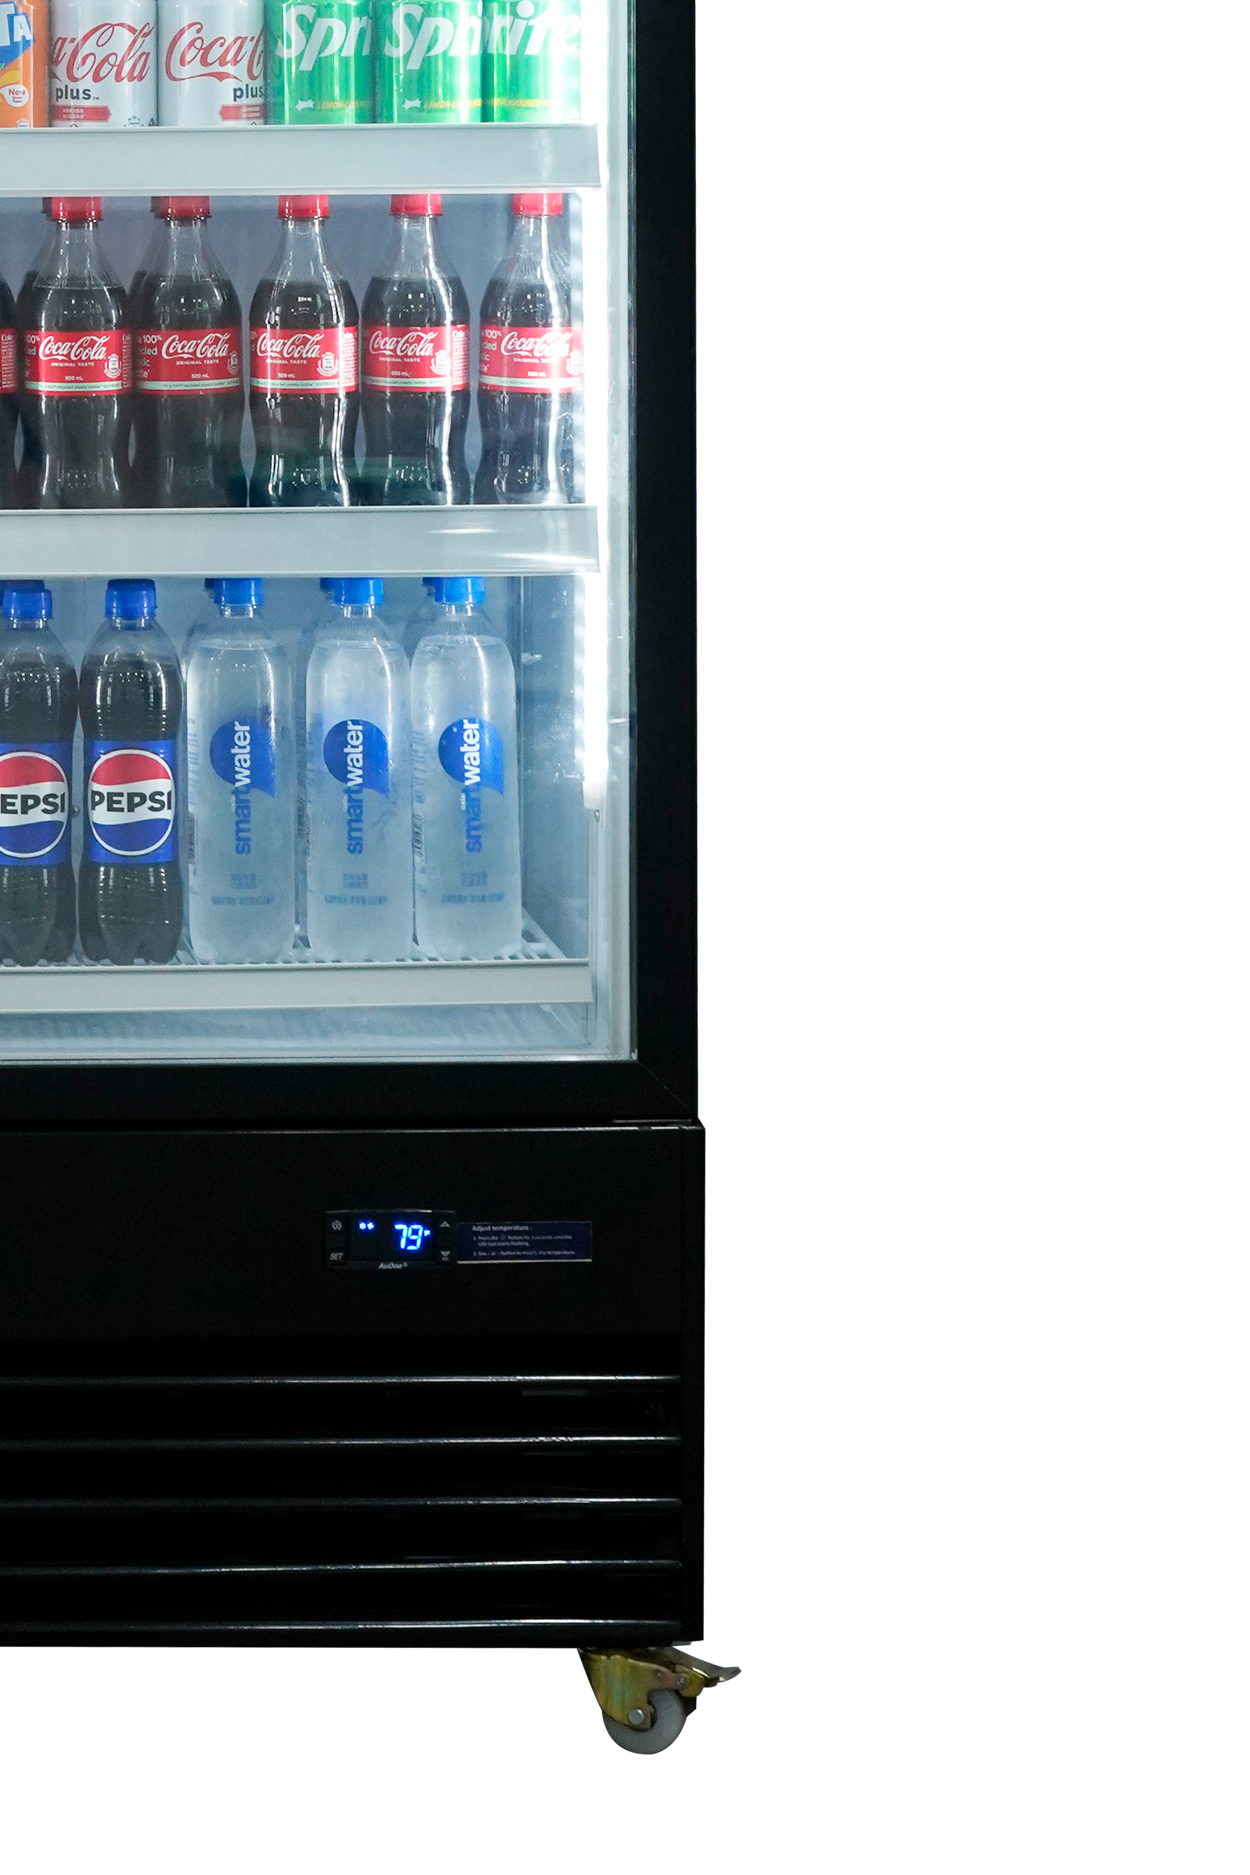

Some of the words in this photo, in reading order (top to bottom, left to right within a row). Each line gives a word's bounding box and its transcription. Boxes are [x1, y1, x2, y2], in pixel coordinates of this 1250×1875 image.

[8, 89, 26, 97] New
[55, 85, 92, 101] plus
[233, 84, 265, 101] plus
[38, 335, 111, 360] Coca-Cola
[161, 332, 231, 359] Coca-Cola
[257, 332, 325, 358] Coca-Cola
[369, 330, 438, 356] Coca-Cola
[90, 790, 172, 813] PEPSI
[472, 1225, 492, 1233] Adjust
[492, 1225, 530, 1233] temperature
[329, 1252, 343, 1261] SET
